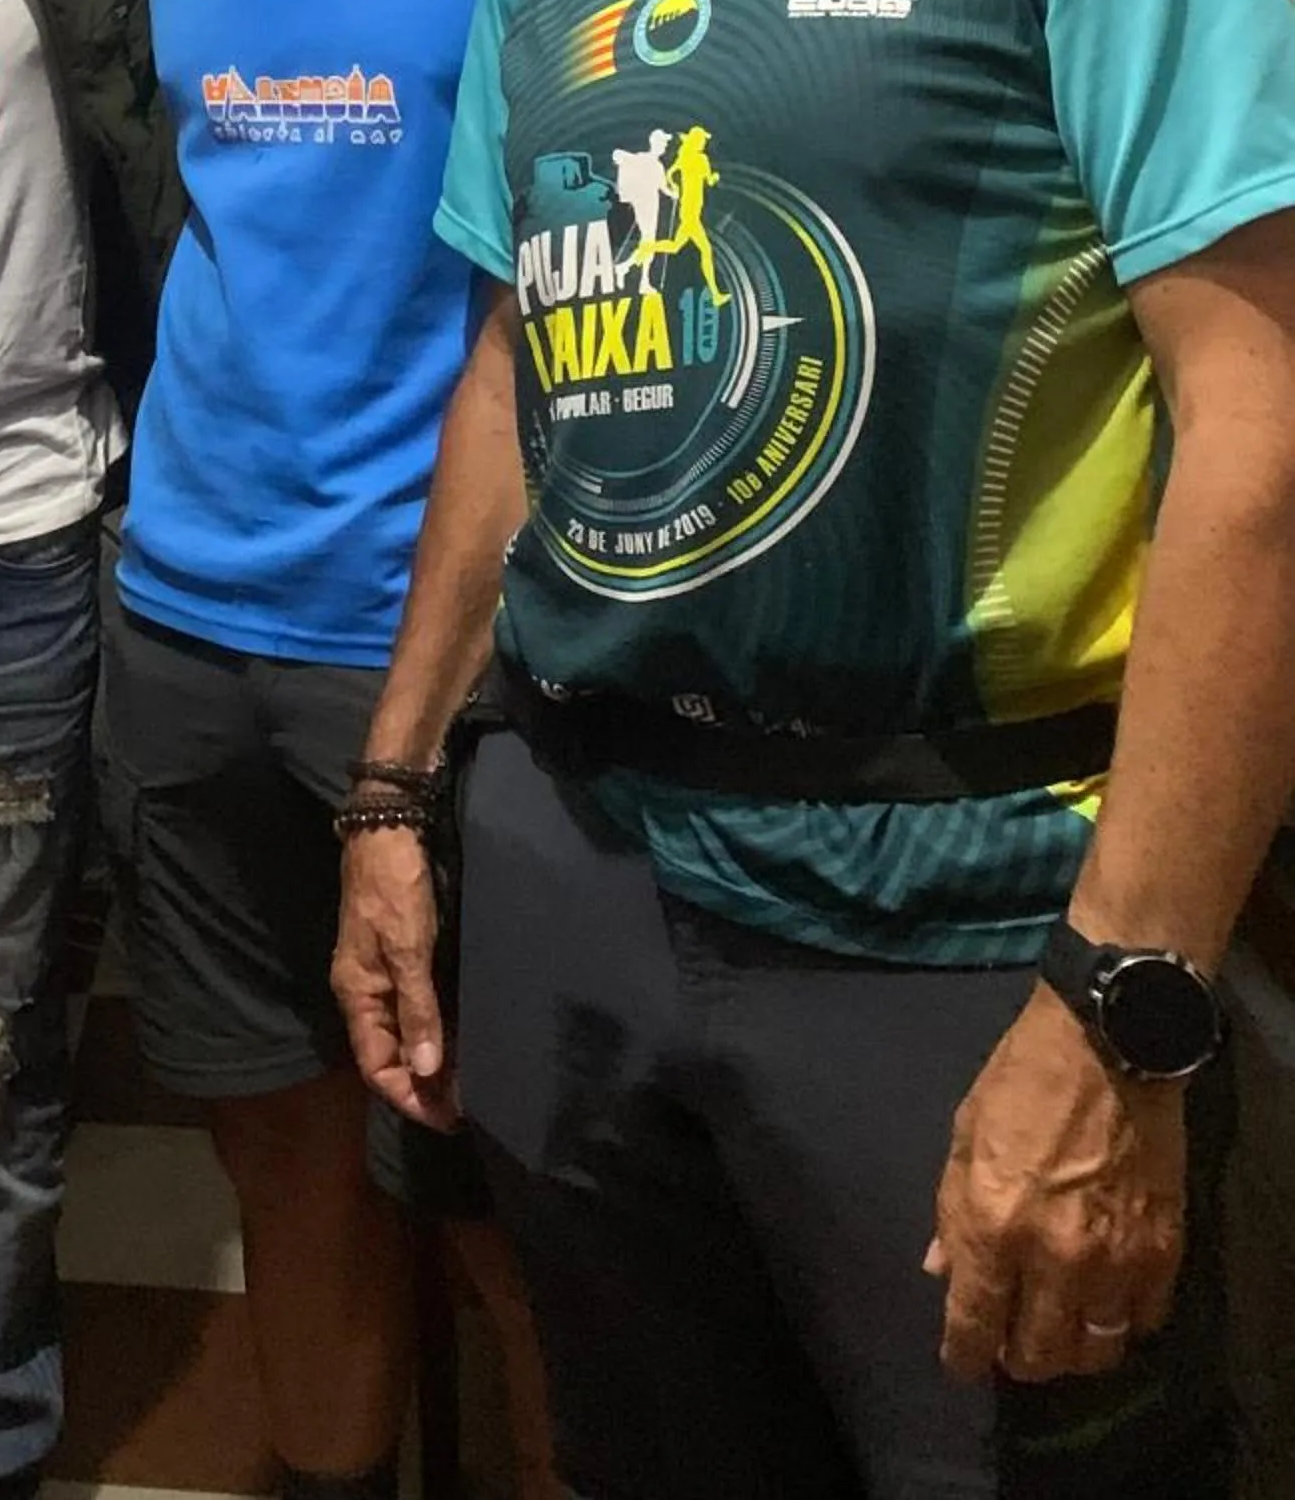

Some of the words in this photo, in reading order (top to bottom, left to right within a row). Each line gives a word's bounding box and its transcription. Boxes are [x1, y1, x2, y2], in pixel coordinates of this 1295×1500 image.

[517, 219, 615, 316] PUJA
[622, 383, 674, 413] BEGUR
[673, 503, 717, 541] 2019
[756, 355, 824, 477] ANIVERSARI
